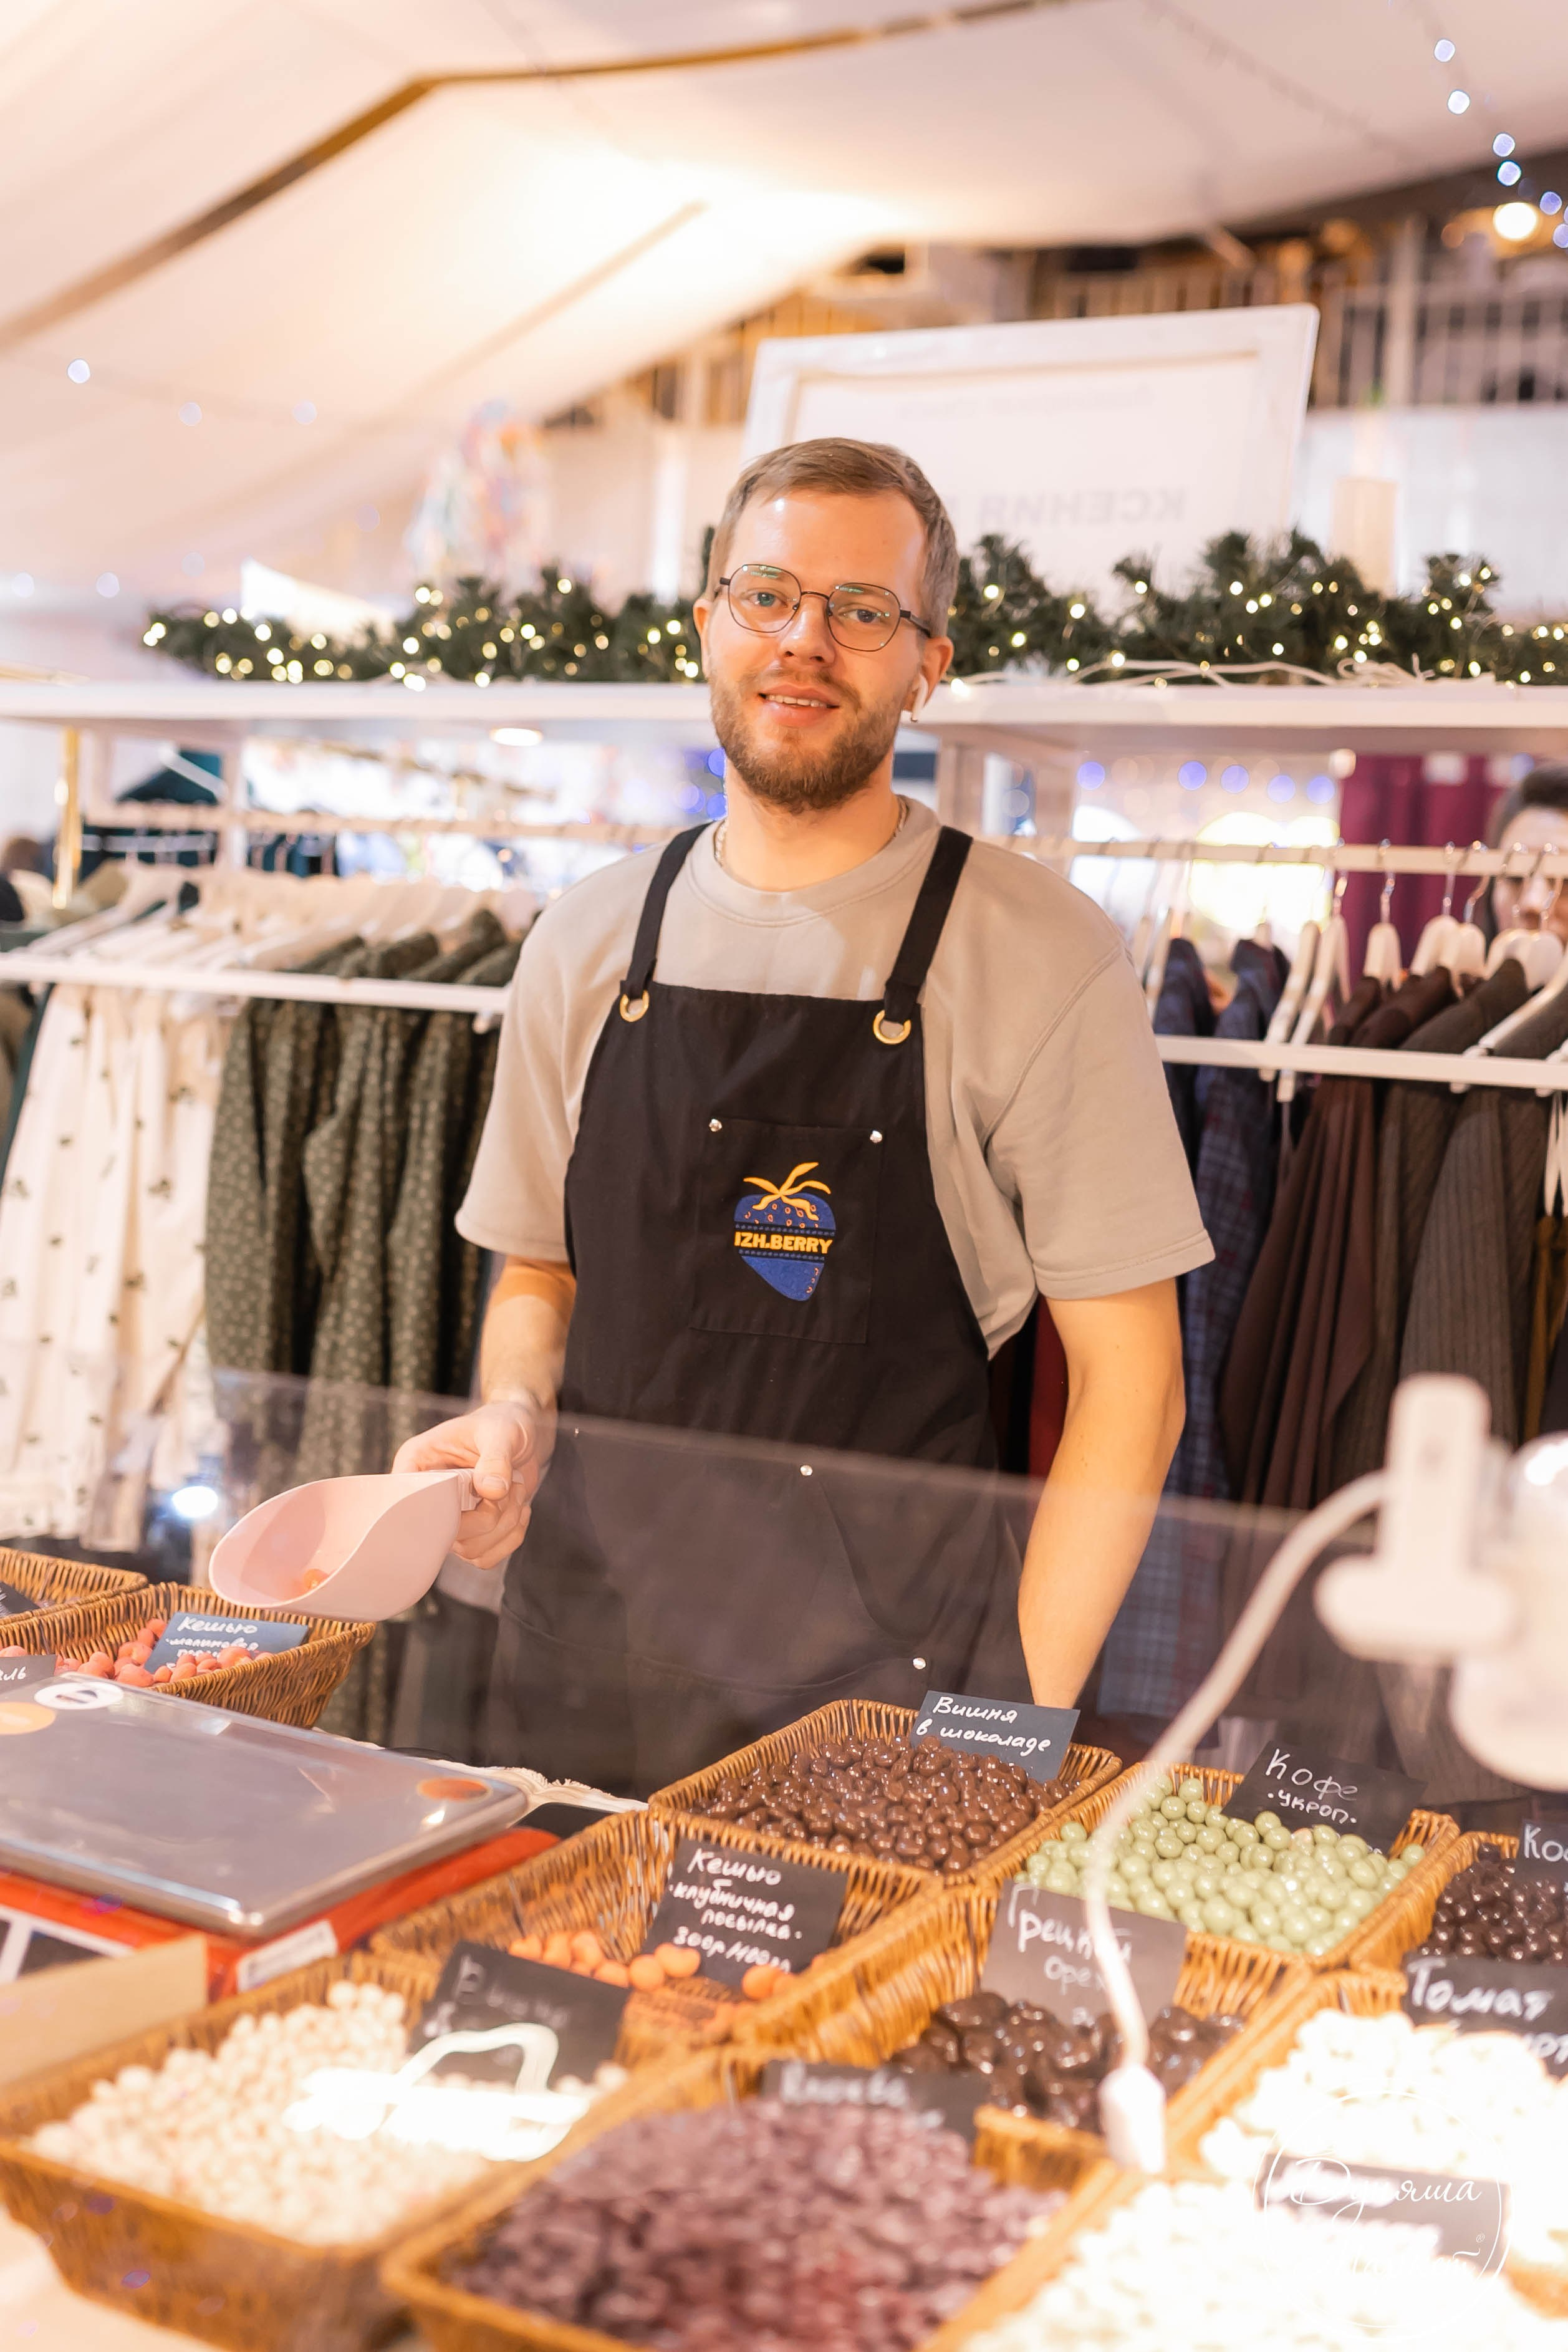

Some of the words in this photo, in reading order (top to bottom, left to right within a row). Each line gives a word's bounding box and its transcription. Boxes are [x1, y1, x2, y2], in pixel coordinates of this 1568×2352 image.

[734, 1231, 833, 1255] IZH.BERRY
[176, 1616, 258, 1634] Кешью
[933, 1696, 1018, 1724] Вишня
[916, 1718, 933, 1736] в
[940, 1727, 1052, 1757] шоколаде
[1265, 1748, 1358, 1801] Кофе
[687, 1848, 782, 1886] Кешью
[1407, 1957, 1556, 2022] Томат
